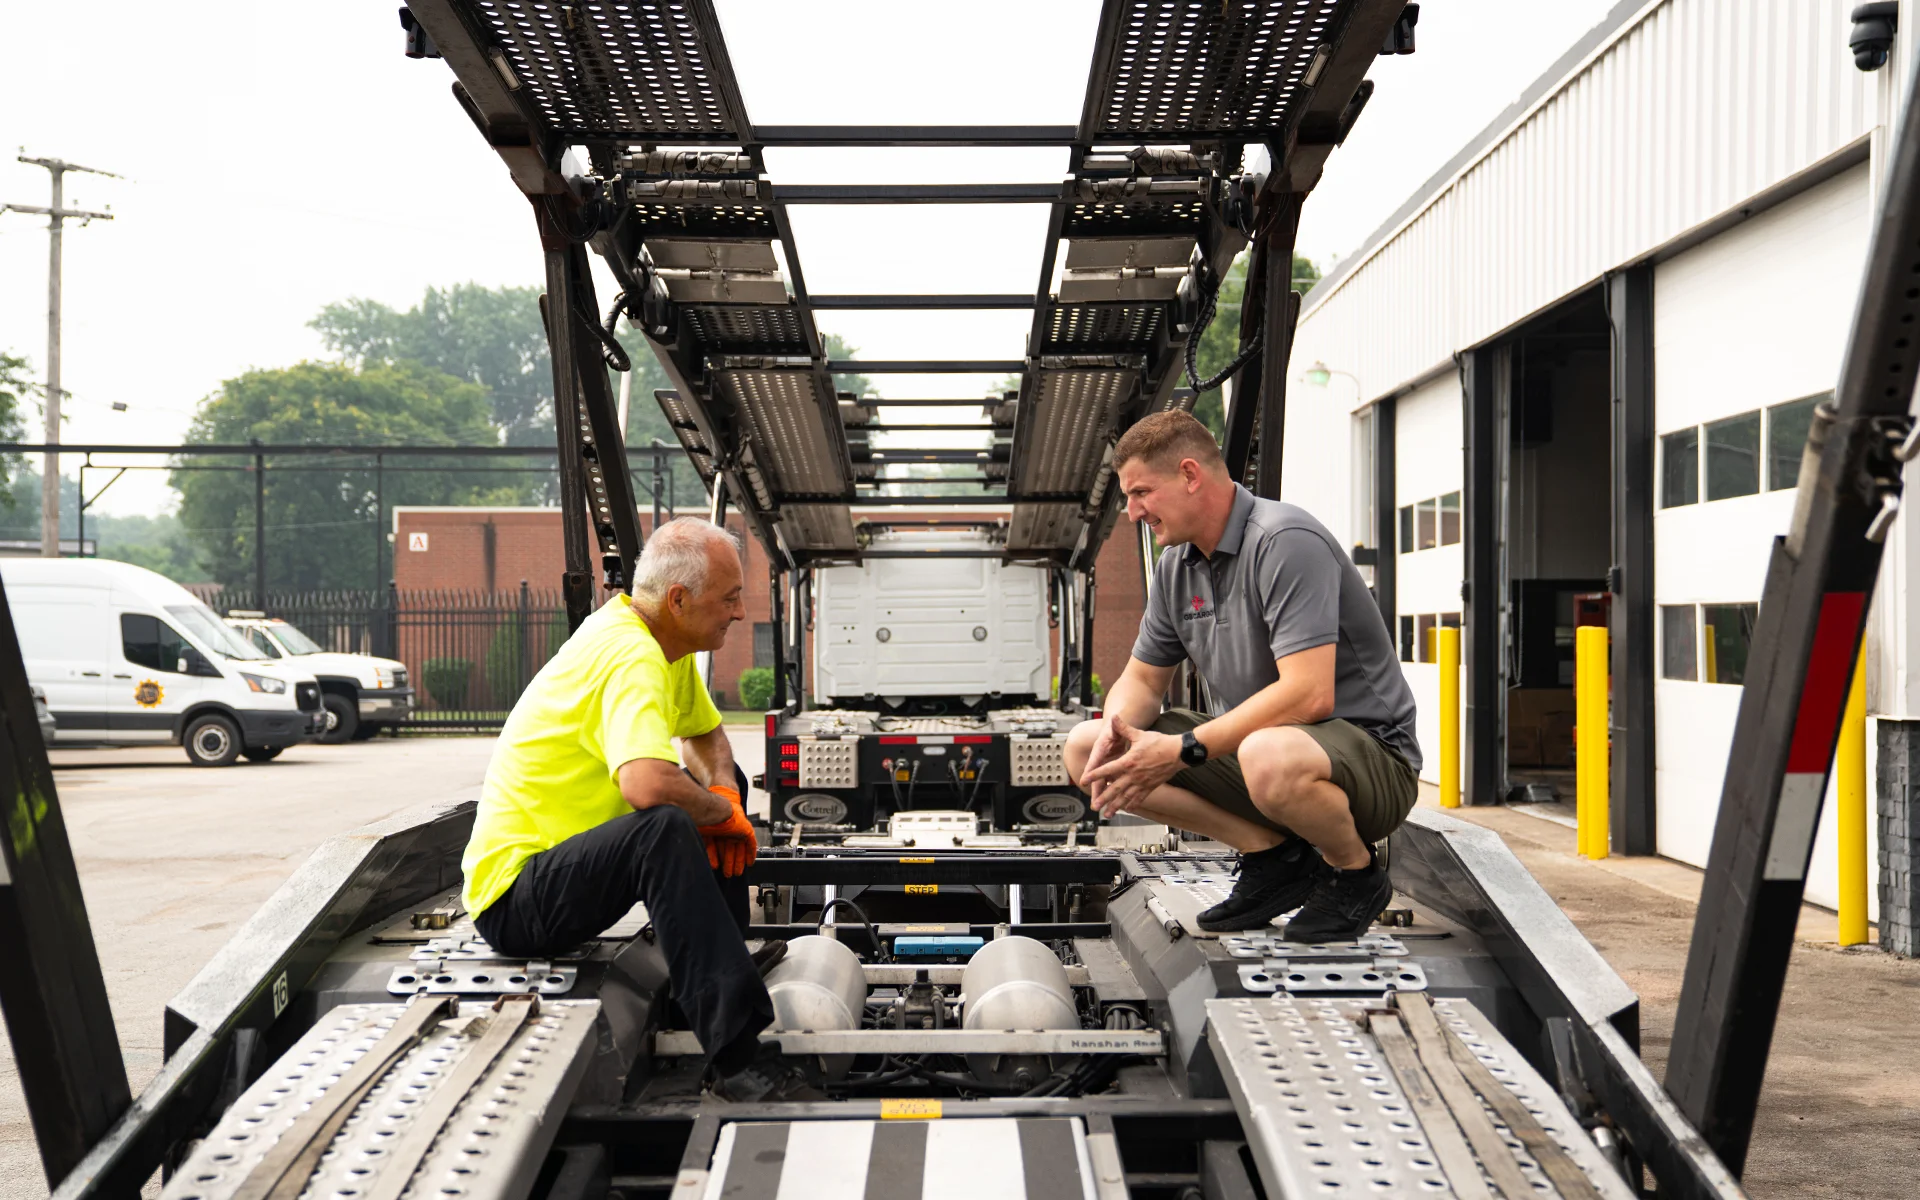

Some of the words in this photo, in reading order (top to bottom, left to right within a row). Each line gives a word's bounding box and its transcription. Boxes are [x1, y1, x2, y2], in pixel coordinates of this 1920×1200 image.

[803, 804, 838, 814] Cottrell
[1041, 804, 1076, 814] Cottrell
[909, 886, 934, 895] STEP
[274, 977, 287, 1012] 16
[1071, 1040, 1128, 1048] Nanshan
